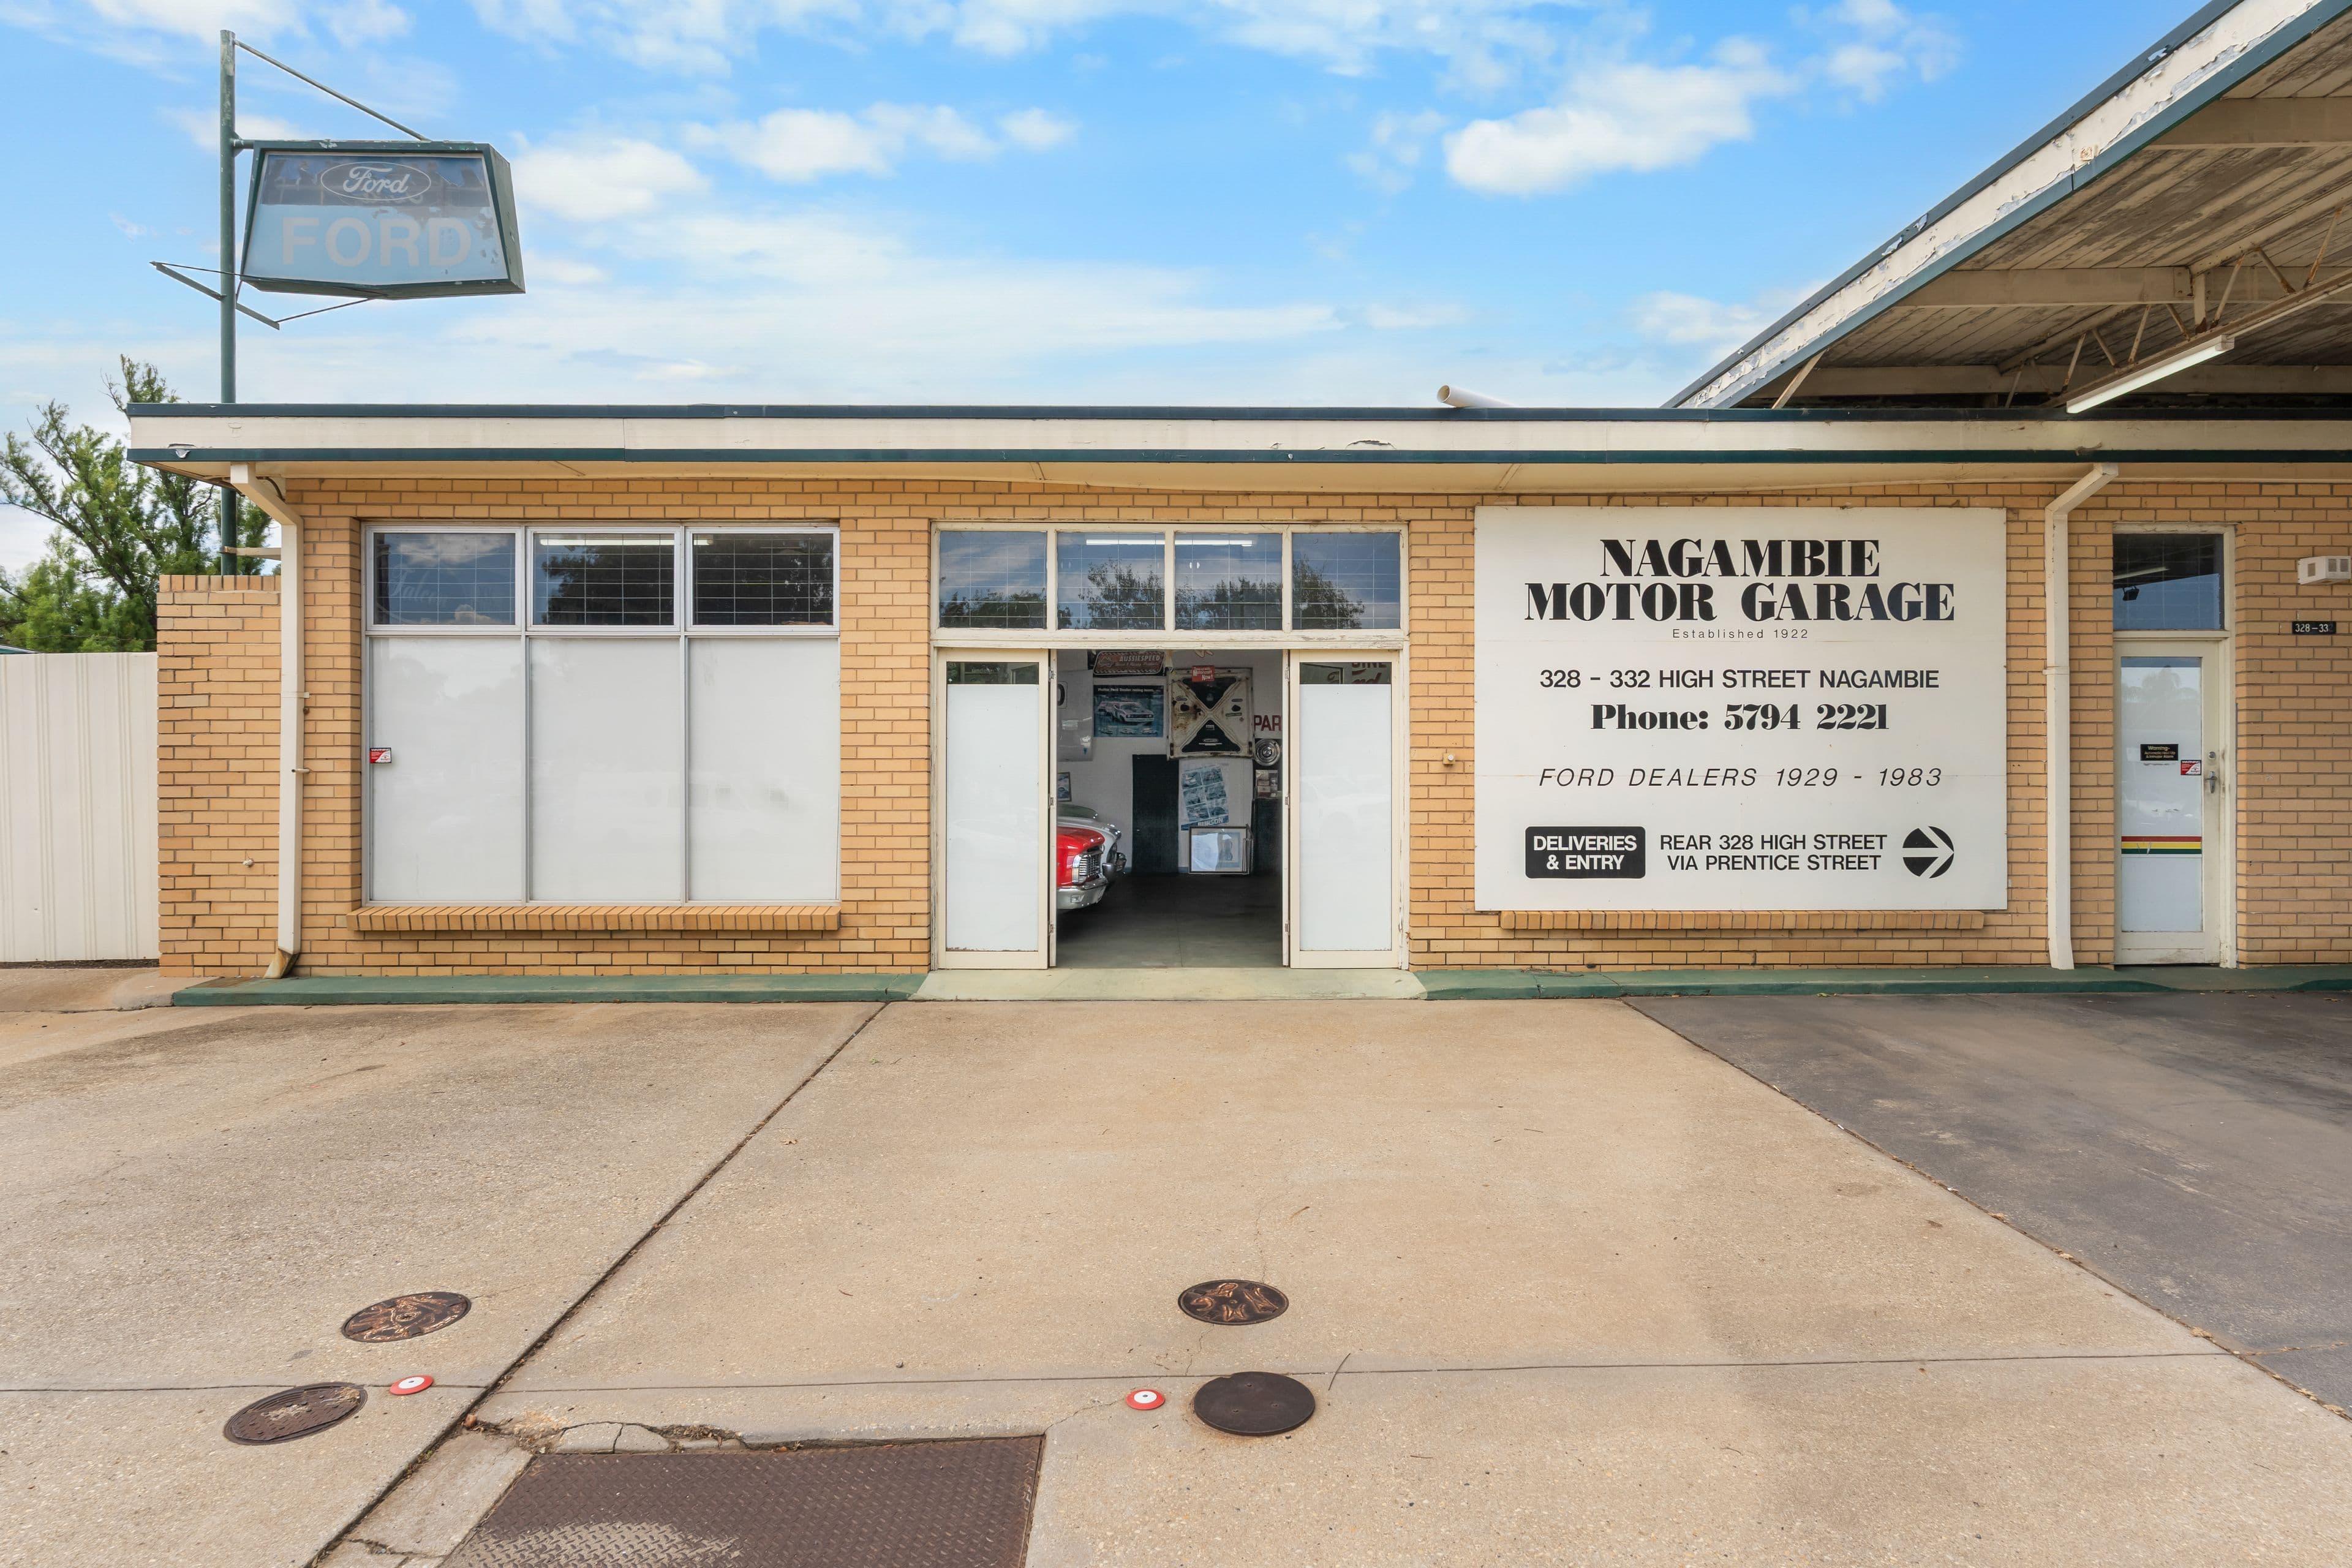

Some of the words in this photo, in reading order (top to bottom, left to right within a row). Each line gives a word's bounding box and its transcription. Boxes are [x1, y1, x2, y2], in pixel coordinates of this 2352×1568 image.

[342, 165, 411, 194] Ford
[282, 217, 472, 267] FORD
[1600, 538, 1880, 578] NAGAMBIE
[1525, 582, 1717, 622] MOTOR
[1741, 582, 1954, 622] GARAGE
[1673, 628, 1764, 639] Established
[1773, 628, 1808, 639] 1922
[1540, 669, 1581, 688] 328
[1610, 669, 1651, 688] 332
[1659, 669, 1713, 688] HIGH
[1722, 669, 1811, 688] STREET
[1820, 669, 1939, 688] NAGAMBIE
[1591, 704, 1708, 730] Phone:
[1724, 704, 1801, 730] 5794
[1817, 704, 1890, 730] 2221
[1539, 768, 1614, 786] FORD
[1629, 768, 1757, 786] DEALERS
[1777, 768, 1838, 786] 1929
[1880, 767, 1942, 786] 1983
[1533, 835, 1637, 851] DELIVERIES
[1660, 834, 1711, 850] REAR
[1719, 834, 1754, 850] 328
[1761, 834, 1806, 850] HIGH
[1813, 834, 1888, 850] STREET
[1546, 854, 1559, 870] &
[1566, 854, 1625, 870] ENTRY
[1667, 855, 1698, 870] VIA
[1706, 854, 1800, 871] PRENTICE
[1807, 854, 1882, 871] STREET
